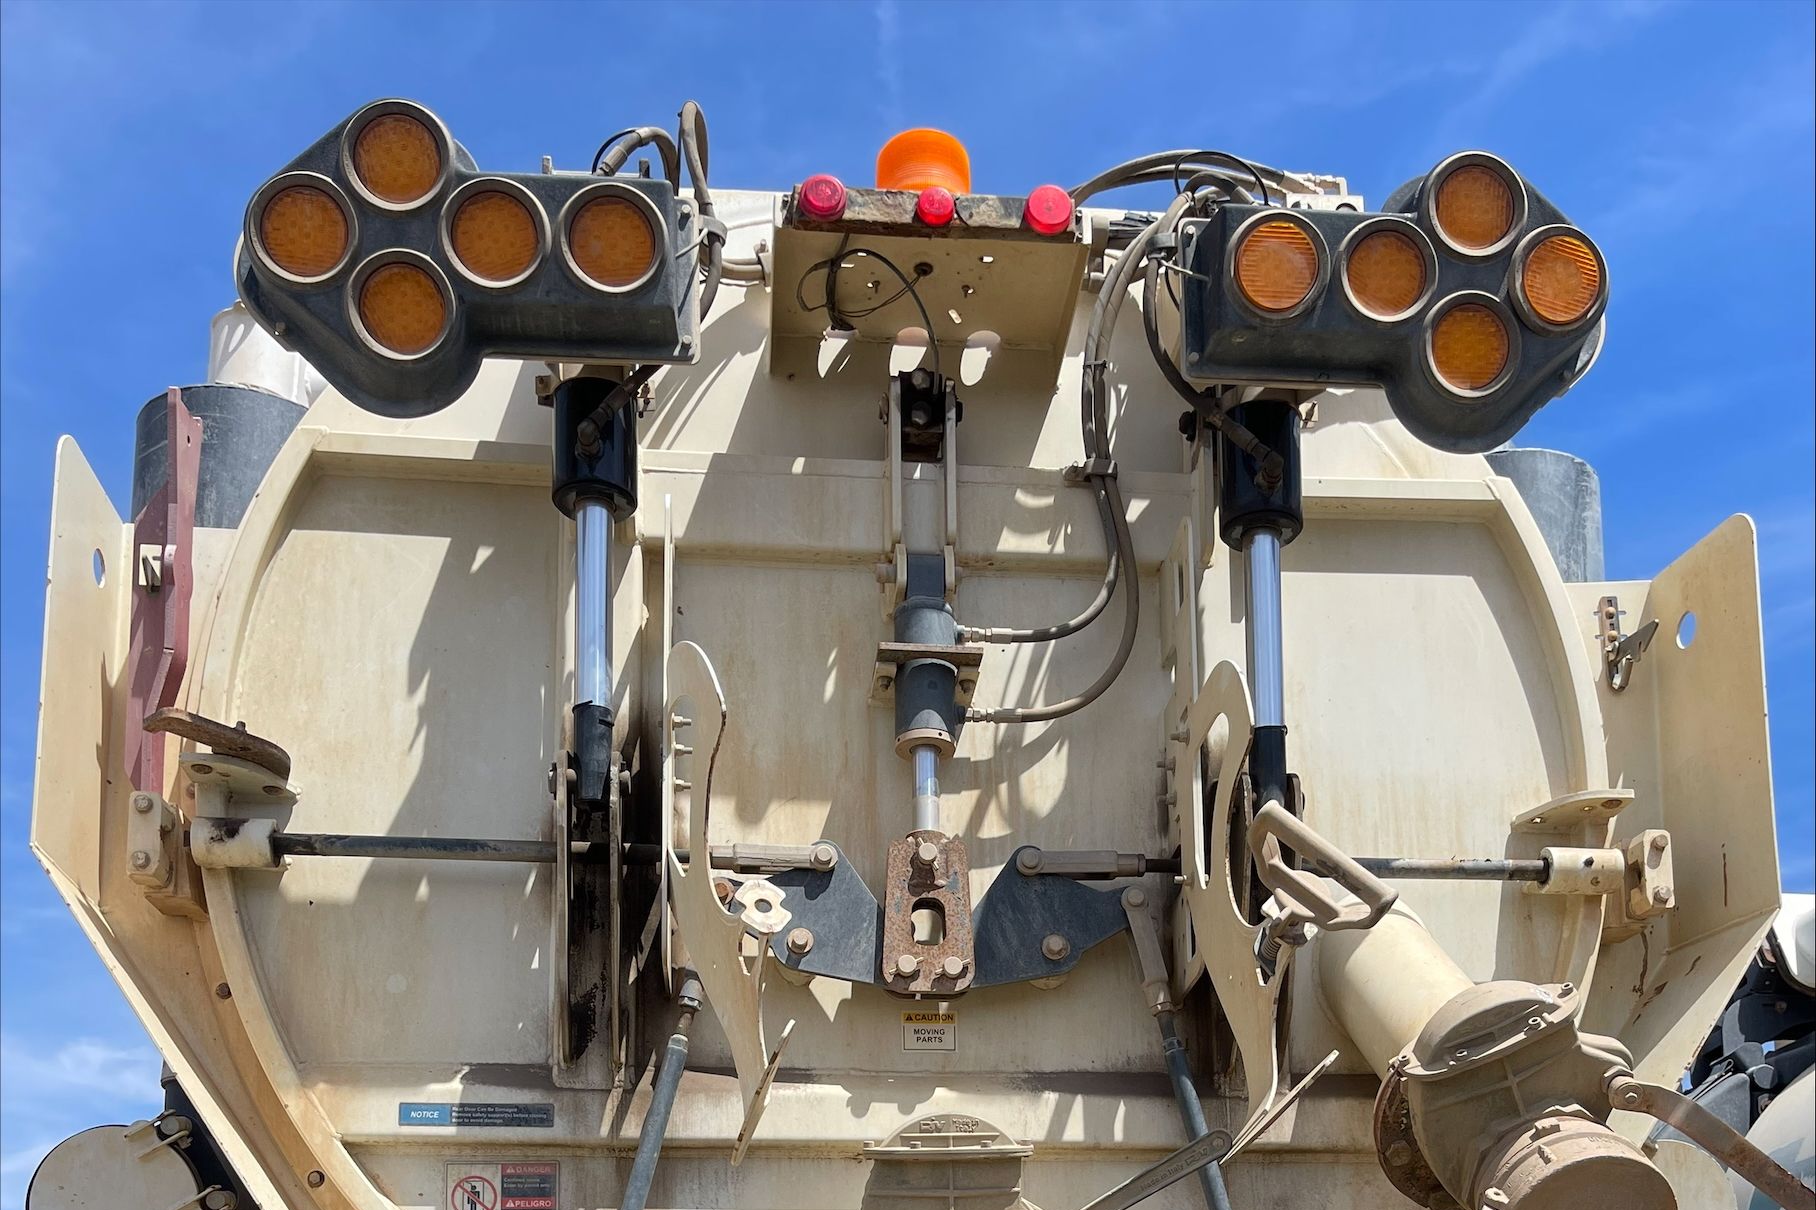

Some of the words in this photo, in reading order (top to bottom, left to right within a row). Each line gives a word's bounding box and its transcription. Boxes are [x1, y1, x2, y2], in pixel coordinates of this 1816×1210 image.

[914, 1013, 954, 1021] CAUTION
[913, 1028, 946, 1036] MOVING
[410, 1110, 440, 1119] NOTICE
